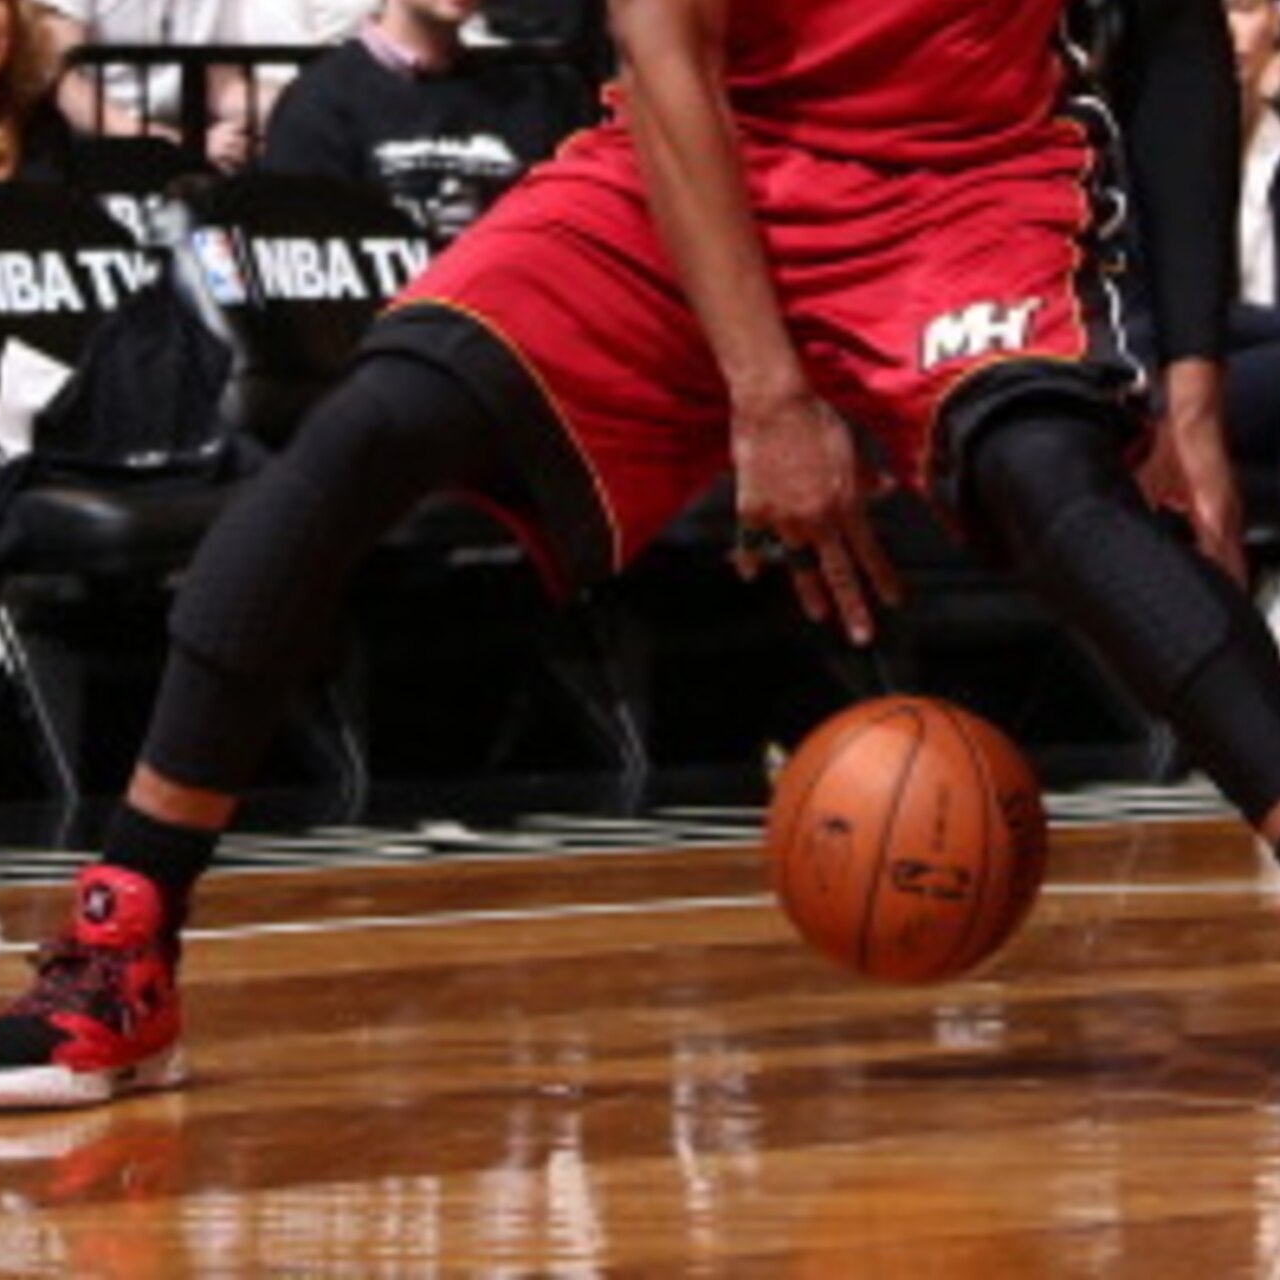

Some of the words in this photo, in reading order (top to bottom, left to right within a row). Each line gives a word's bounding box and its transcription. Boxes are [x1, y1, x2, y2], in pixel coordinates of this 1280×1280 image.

[75, 250, 161, 311] TV
[250, 236, 369, 300] NBA
[360, 236, 430, 299] TV
